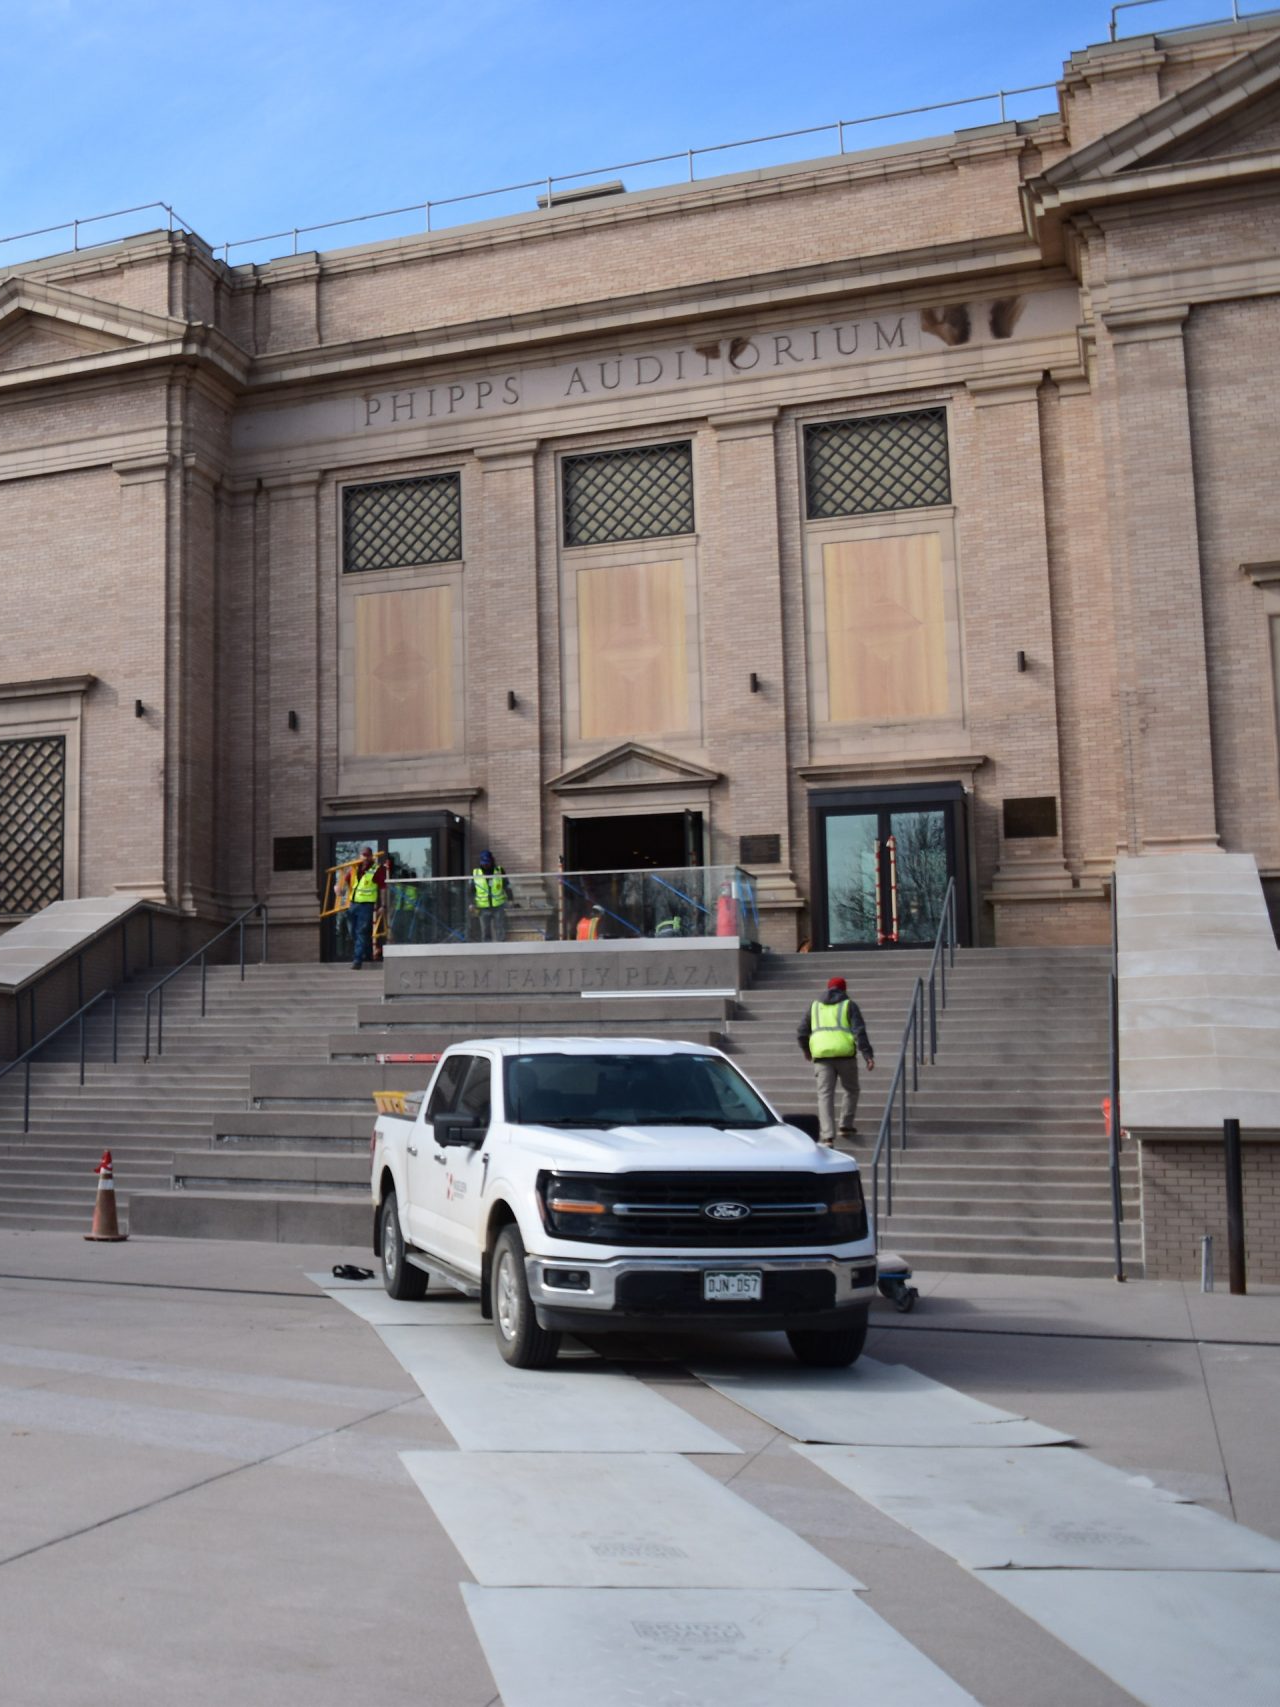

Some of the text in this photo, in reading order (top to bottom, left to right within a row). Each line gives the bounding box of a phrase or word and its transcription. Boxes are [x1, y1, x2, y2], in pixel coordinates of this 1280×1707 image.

[365, 317, 908, 426] PHIPPS AUDITORIUM
[399, 965, 719, 990] STURM FAMILY PLAZA
[713, 1205, 742, 1217] Ford
